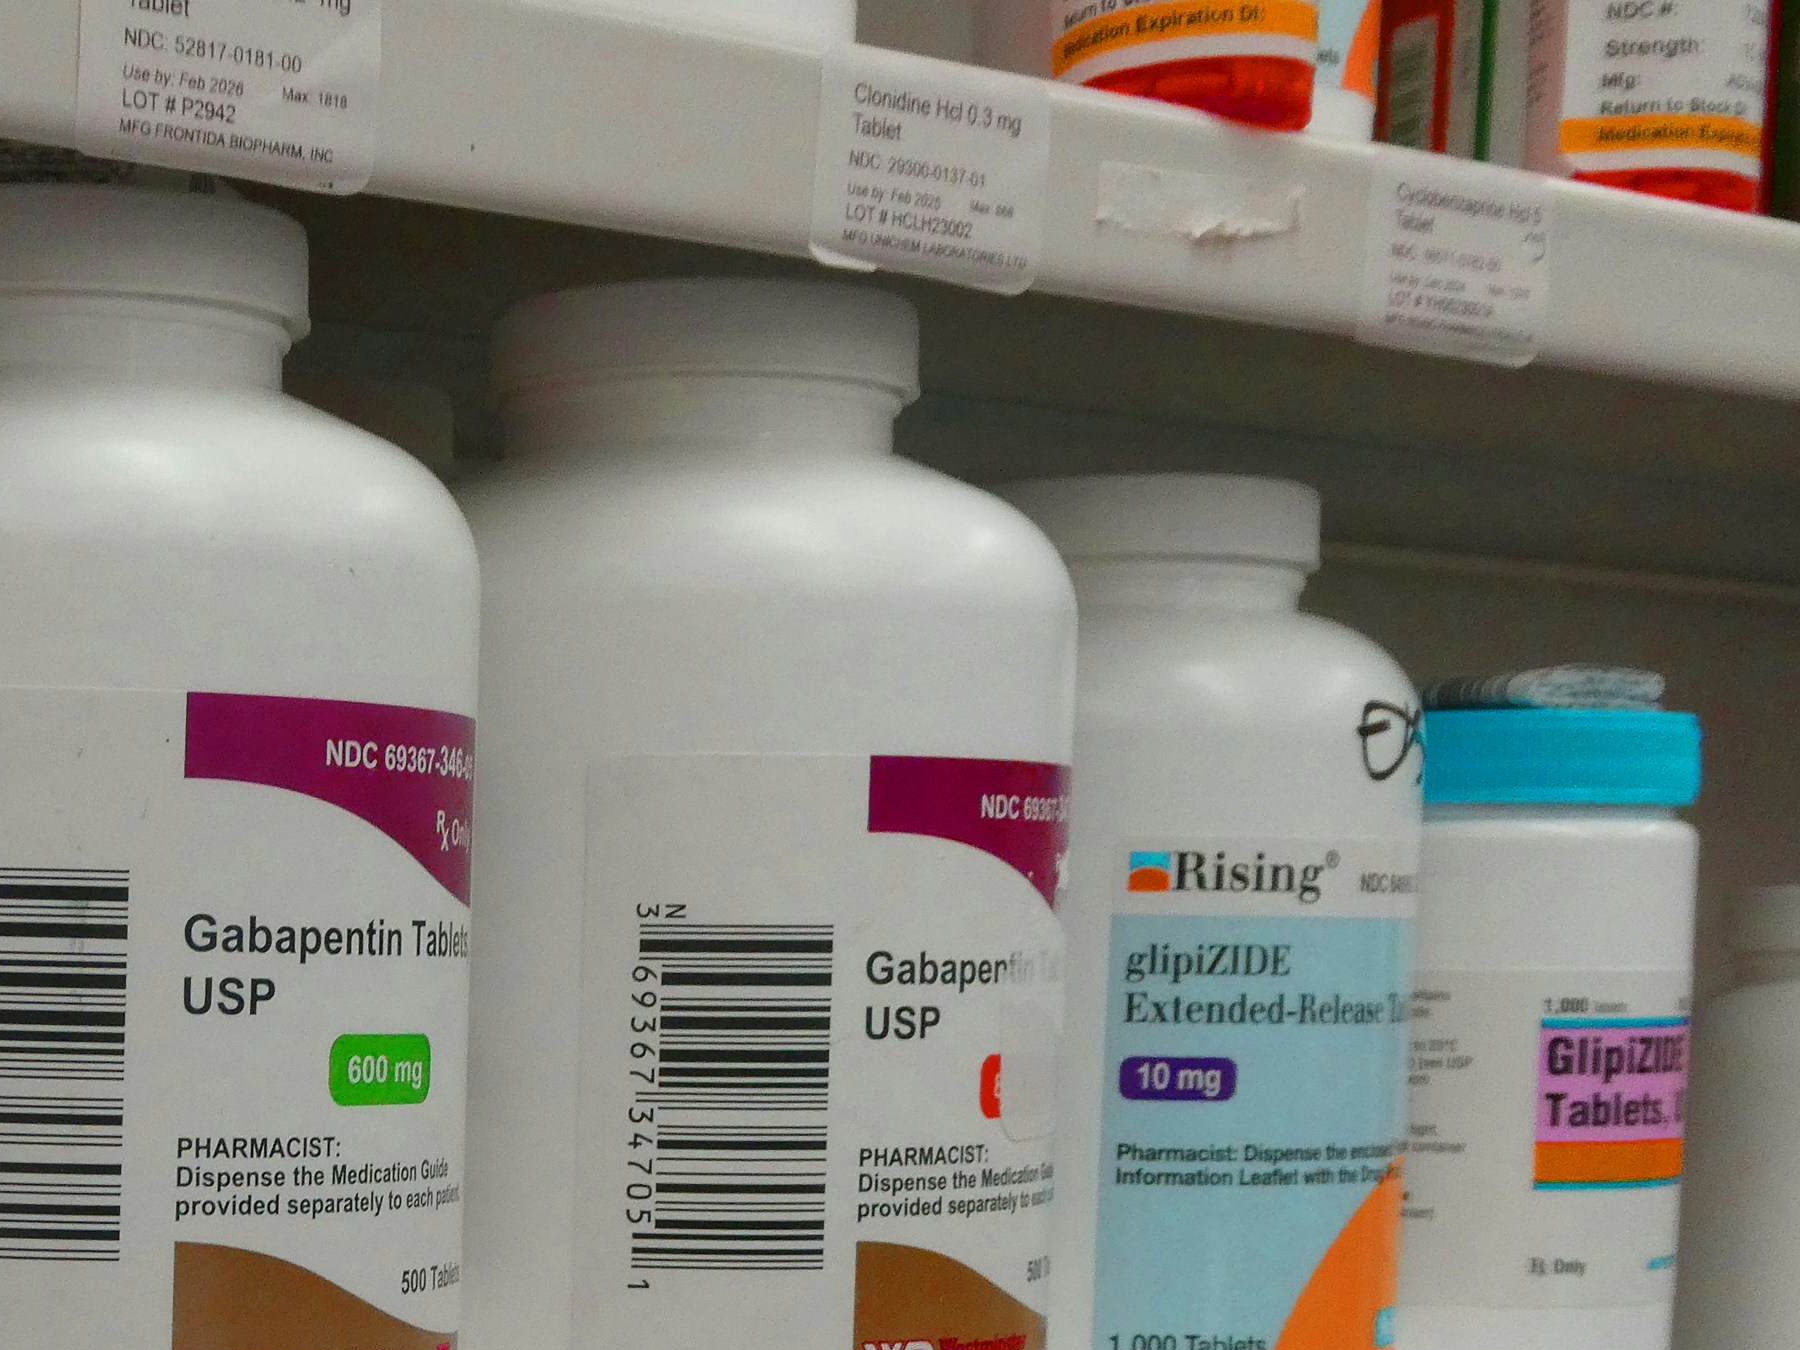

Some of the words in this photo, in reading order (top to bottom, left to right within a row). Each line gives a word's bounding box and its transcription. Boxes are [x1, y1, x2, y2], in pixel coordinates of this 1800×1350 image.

[1606, 1, 1653, 20] NDC
[174, 36, 303, 73] 52817-0181-00
[123, 63, 150, 82] Use
[179, 72, 206, 91] Feb
[121, 89, 160, 113] LOT
[182, 97, 237, 124] P2942
[854, 82, 932, 118] Clonidine
[967, 103, 994, 129] 0.3
[996, 113, 1023, 139] mg
[119, 118, 151, 136] MFG
[154, 122, 226, 149] FRONTIDA
[310, 148, 334, 163] INC
[853, 111, 903, 141] Tablet
[325, 739, 379, 770] NDC
[979, 792, 1021, 821] NDC
[183, 912, 403, 966] Gabapentin
[1123, 943, 1293, 984] glipiZIDE
[183, 975, 277, 1017] USP
[1123, 991, 1383, 1027] Extended-Release
[864, 1005, 941, 1040] USP
[347, 1053, 389, 1085] 600
[393, 1056, 424, 1091] mg
[1136, 1061, 1171, 1092] 10
[1176, 1065, 1222, 1098] mg
[176, 1135, 342, 1160] PHARMACIST:
[858, 1143, 989, 1168] PHARMACIST:
[1244, 1143, 1322, 1167] Dispense
[175, 1164, 287, 1192] Dispense
[292, 1164, 326, 1188] the
[330, 1162, 418, 1187] Medication
[419, 1156, 450, 1182] Guide
[857, 1171, 948, 1198] Dispense
[952, 1170, 977, 1190] the
[1114, 1166, 1234, 1187] Information
[1237, 1166, 1300, 1187] Leaflet
[174, 1192, 280, 1223] provided
[286, 1190, 385, 1220] separately
[387, 1190, 403, 1211] to
[404, 1185, 434, 1209] each
[857, 1195, 943, 1223] provided
[947, 1194, 1020, 1218] separately
[400, 1266, 428, 1296] 500
